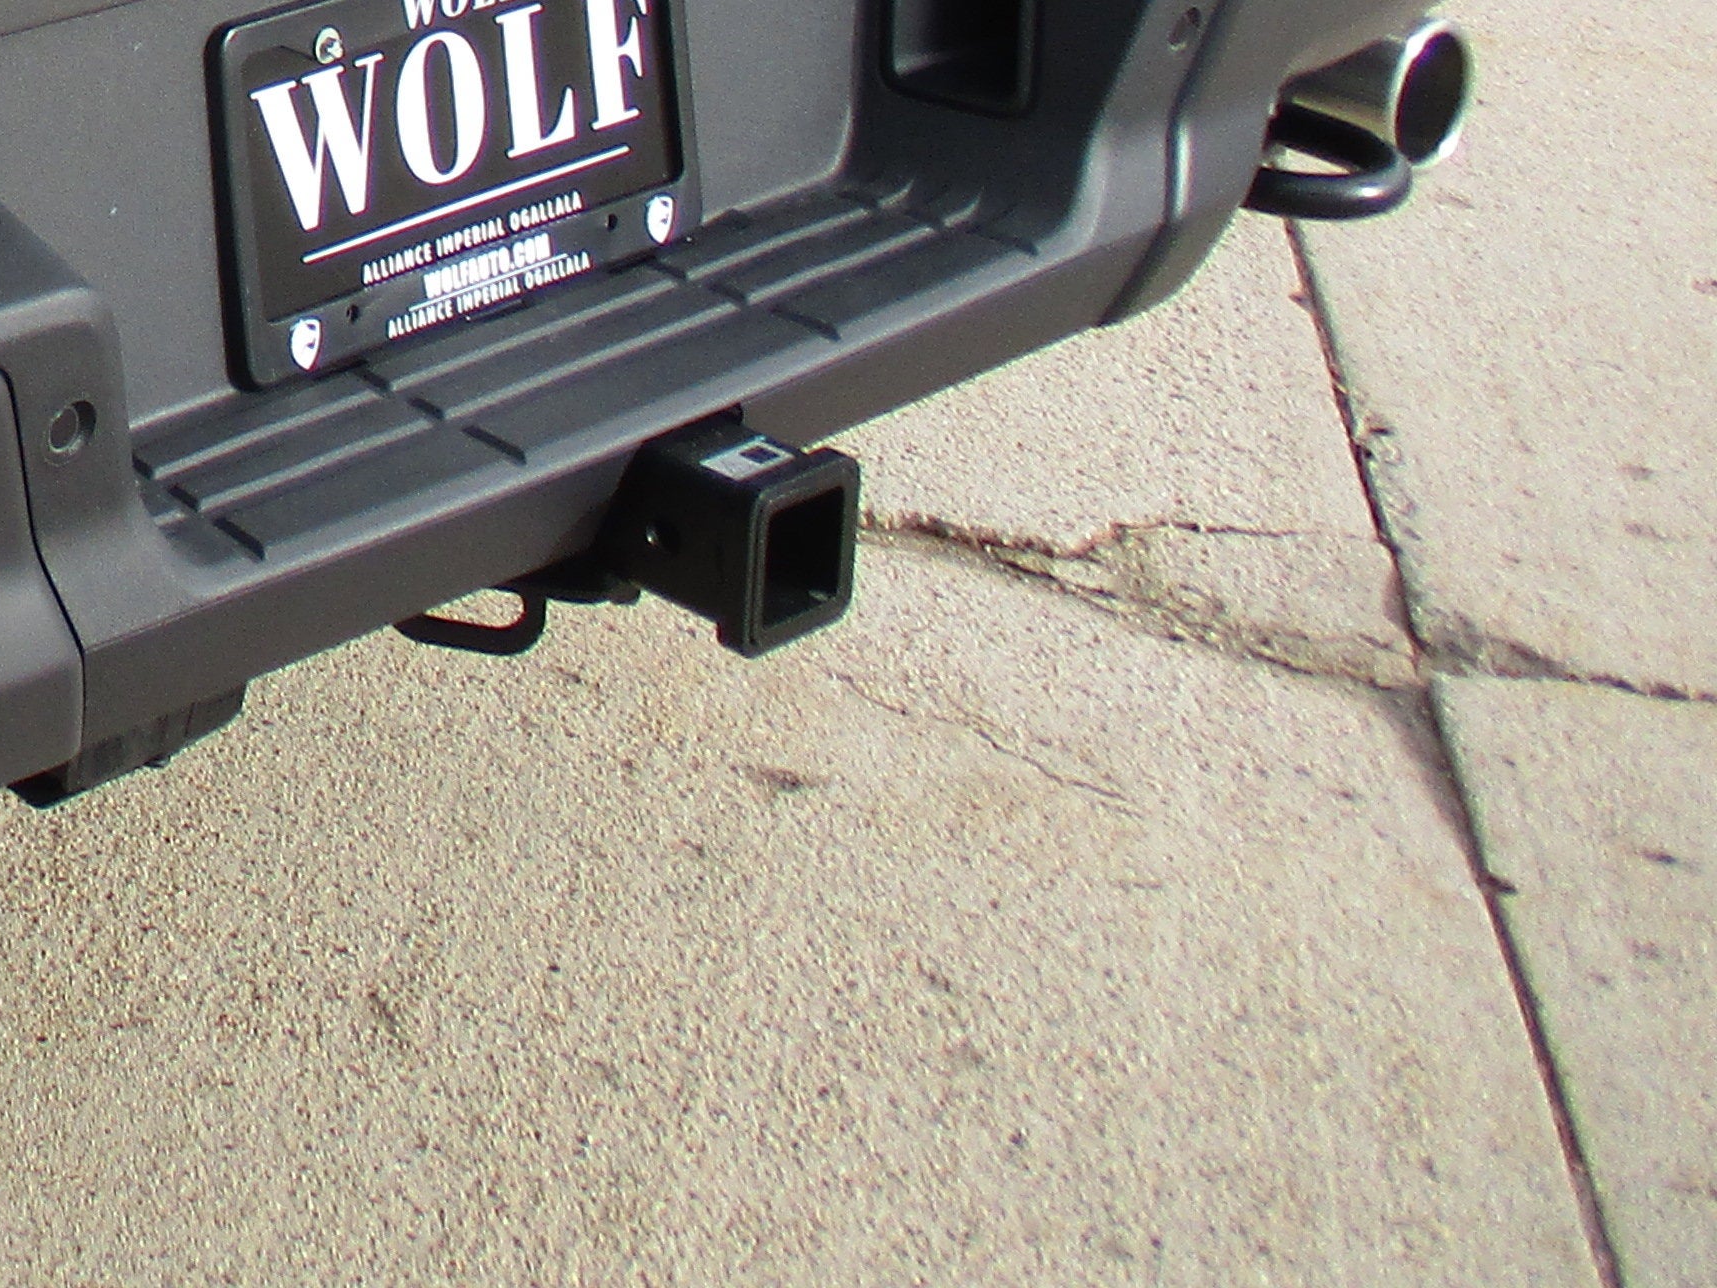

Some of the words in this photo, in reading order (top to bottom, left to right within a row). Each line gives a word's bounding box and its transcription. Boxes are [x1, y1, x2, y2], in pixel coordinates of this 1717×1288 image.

[362, 240, 434, 284] ALLIANCE
[435, 216, 505, 255] IMPERIAL
[508, 190, 583, 232] OGALLALA
[423, 232, 552, 299] WOLFAUTO.COM
[387, 301, 454, 340] ALLIANCE
[456, 279, 521, 315] IMPERIAL
[523, 251, 592, 290] OGALLALA
